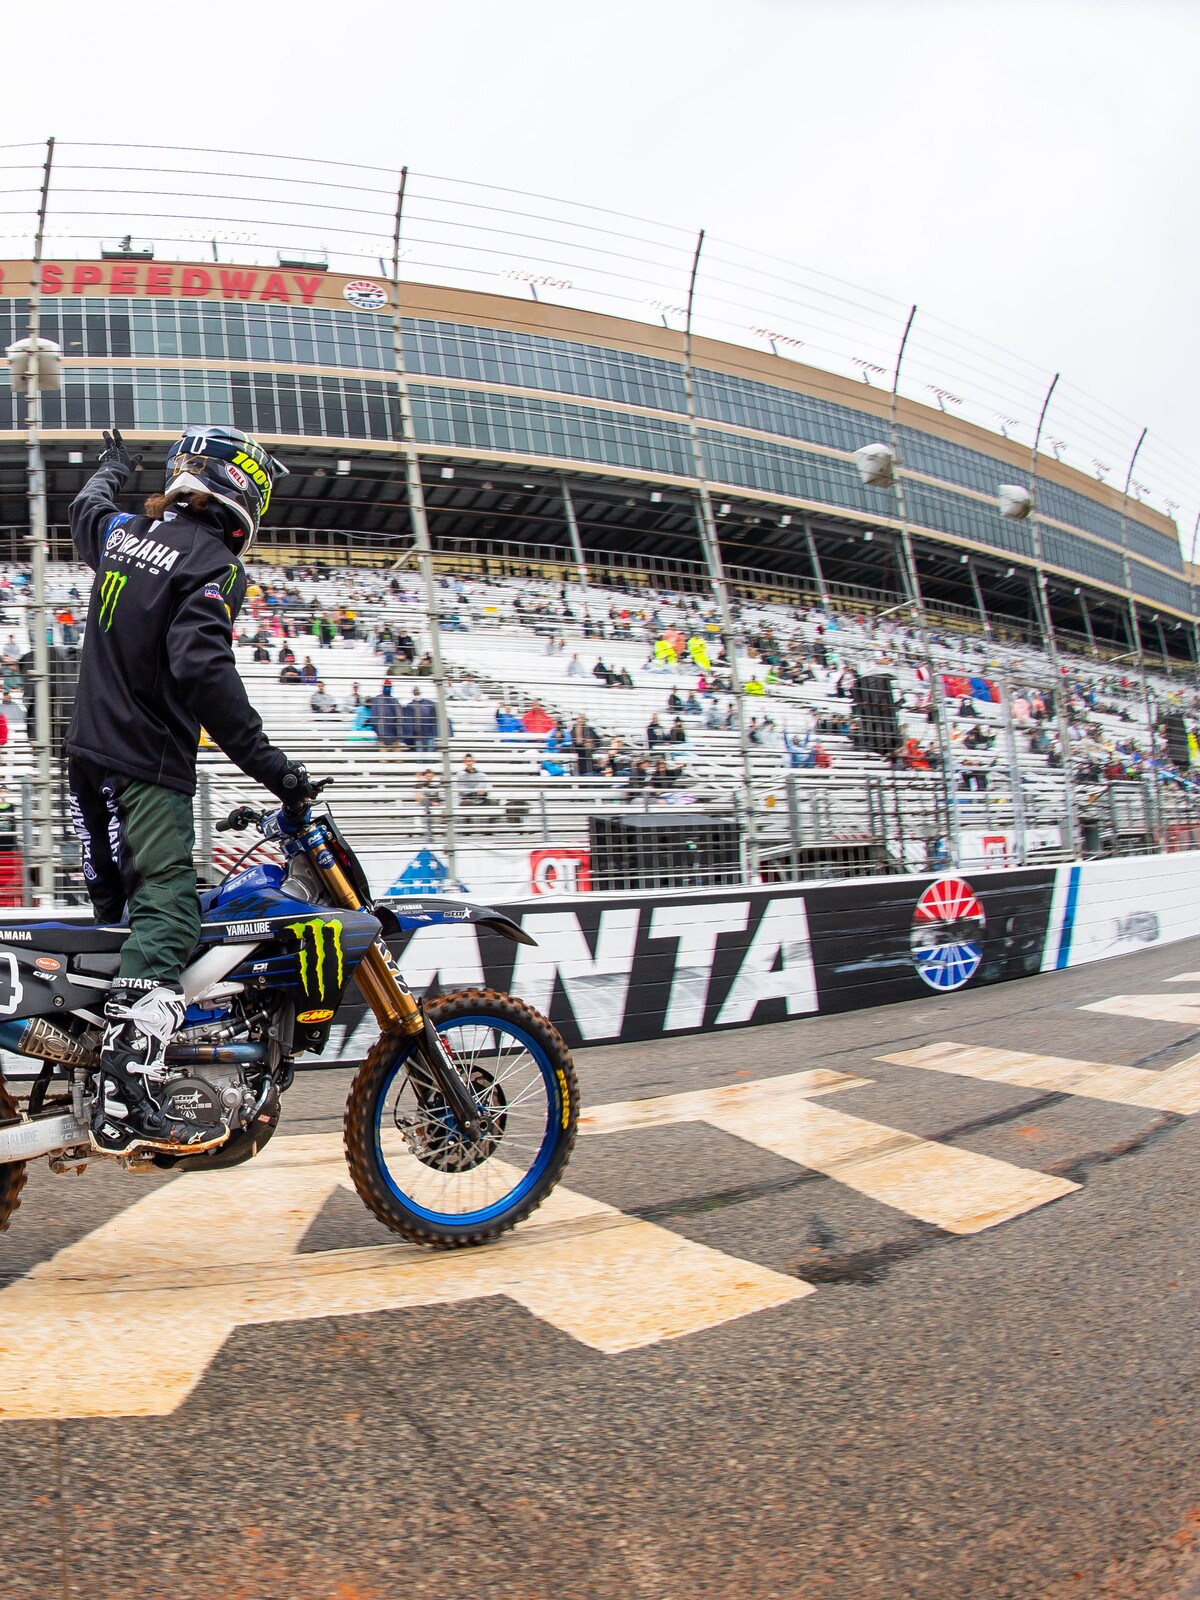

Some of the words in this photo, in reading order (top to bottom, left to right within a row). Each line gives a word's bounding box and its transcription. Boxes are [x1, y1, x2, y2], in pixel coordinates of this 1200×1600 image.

[40, 264, 324, 304] SPEEDWAY
[228, 466, 245, 487] BELL
[232, 450, 271, 500] 100%
[104, 551, 160, 575] RACING
[117, 532, 180, 572] YAMAHA
[535, 857, 581, 895] QT
[226, 922, 270, 936] YAMALUBE
[297, 1010, 334, 1021] FMF
[175, 1102, 212, 1110] KLUSE
